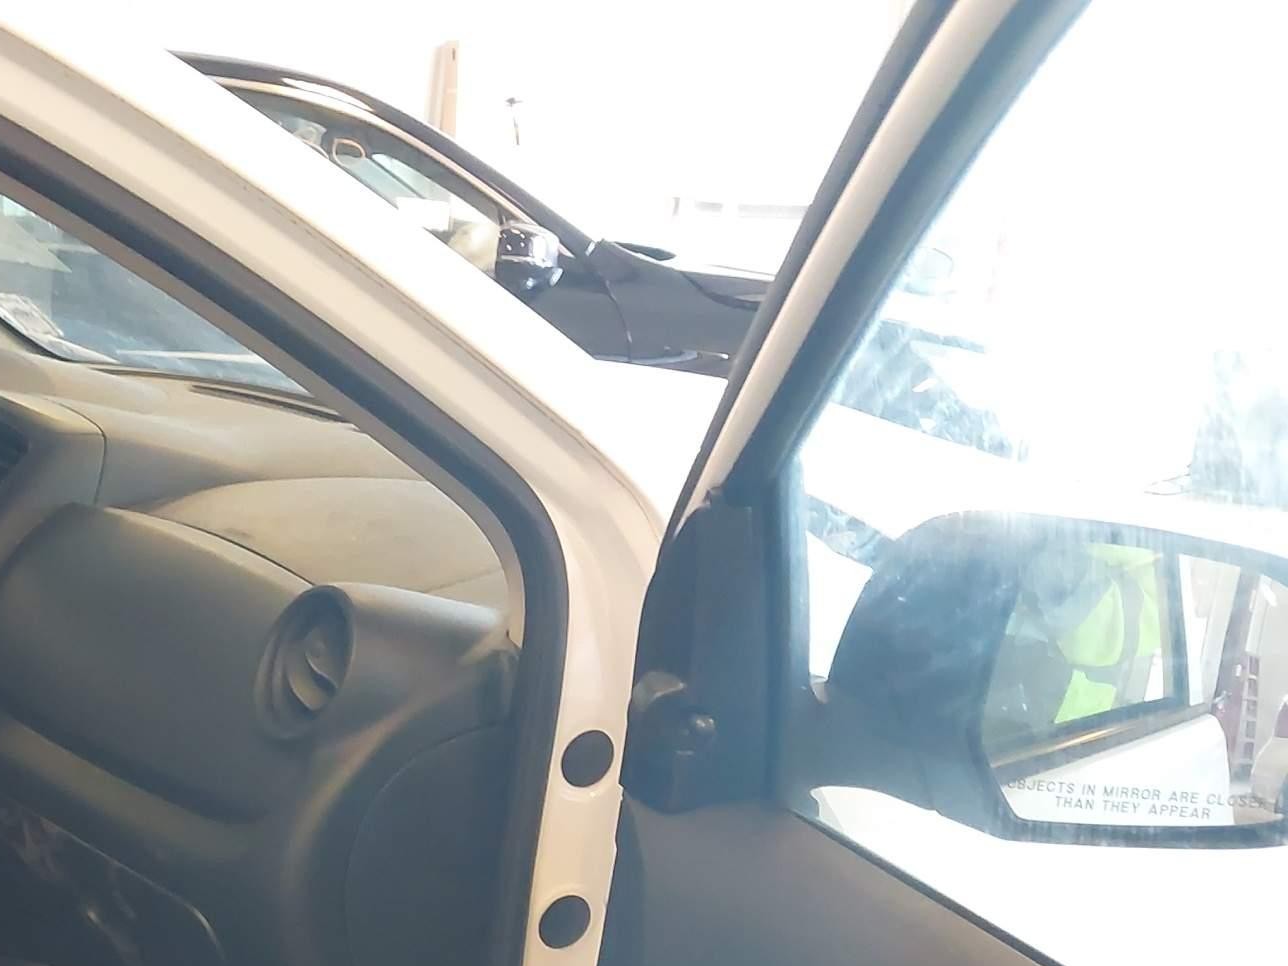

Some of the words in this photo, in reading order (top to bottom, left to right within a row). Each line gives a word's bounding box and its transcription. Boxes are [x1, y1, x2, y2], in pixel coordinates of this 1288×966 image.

[1081, 784, 1096, 796] IN
[1103, 785, 1161, 801] MIRROR
[1168, 790, 1201, 804] ARE
[1055, 795, 1095, 810] THAN
[1102, 799, 1141, 813] THEY
[1148, 803, 1212, 819] APPEAR
